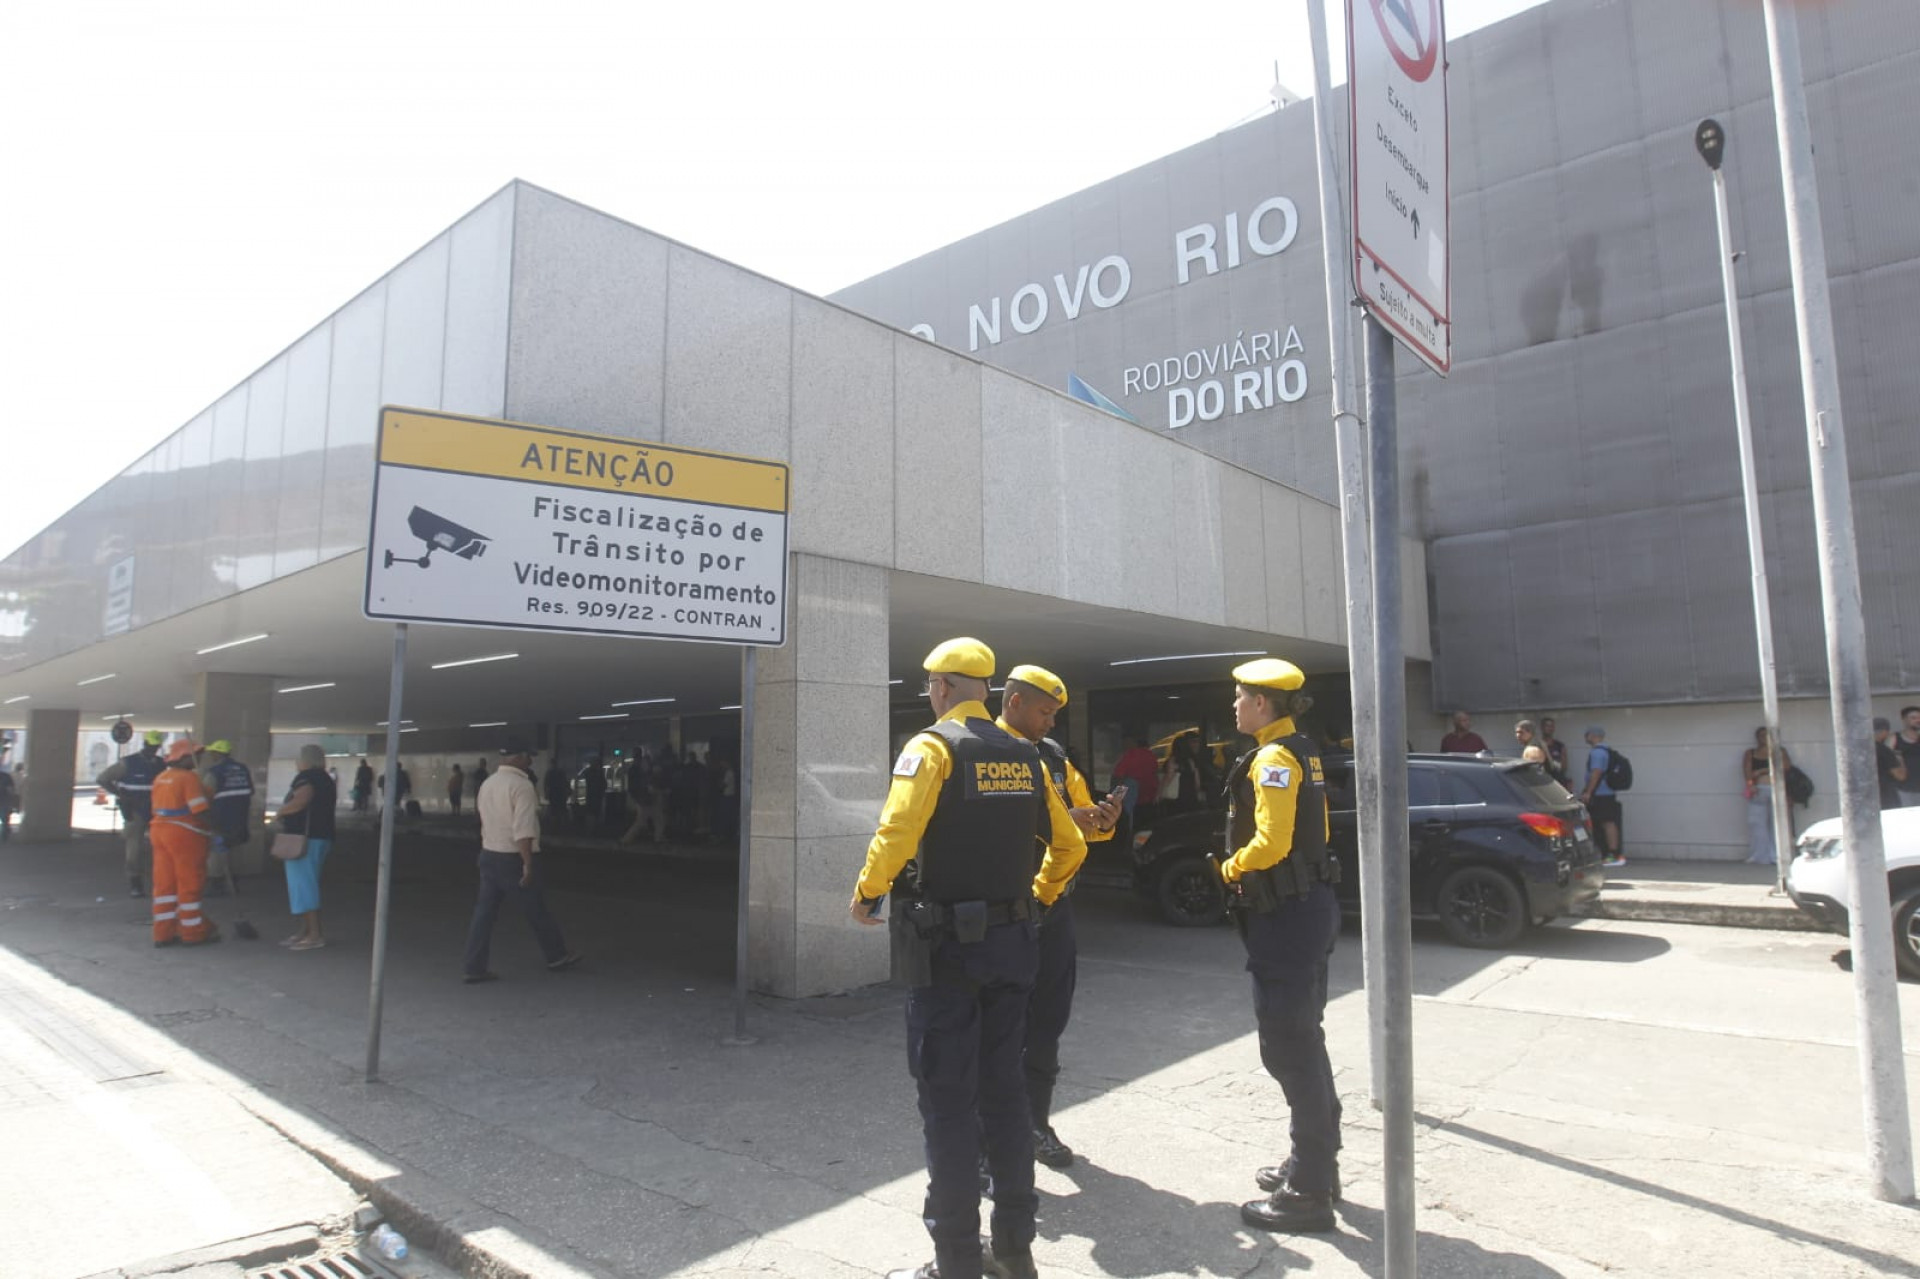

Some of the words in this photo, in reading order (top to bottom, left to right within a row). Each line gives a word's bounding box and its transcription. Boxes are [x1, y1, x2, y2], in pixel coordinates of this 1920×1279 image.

[1388, 85, 1418, 132] Exceto
[1377, 122, 1429, 194] Desembarque
[968, 255, 1131, 351] NOVO
[1175, 196, 1298, 285] RIO
[1380, 282, 1409, 321] Sujeito
[1409, 313, 1415, 327] a
[1416, 317, 1436, 347] multa
[1124, 325, 1304, 396] RODOVIÁRIA
[1169, 380, 1225, 429] DO
[1234, 360, 1308, 414] RIO
[520, 442, 674, 487] ATENÇÃO
[533, 496, 722, 539] Fiscalização
[732, 521, 764, 543] de
[552, 531, 685, 566] Trânsito
[699, 551, 746, 573] por
[514, 561, 776, 606] Videomonitoramento
[527, 597, 569, 615] Res.
[577, 601, 654, 621] 909/22
[674, 608, 762, 630] CONTRAN
[975, 762, 1033, 781] FORÇA
[977, 779, 1035, 792] MUNICIPAL
